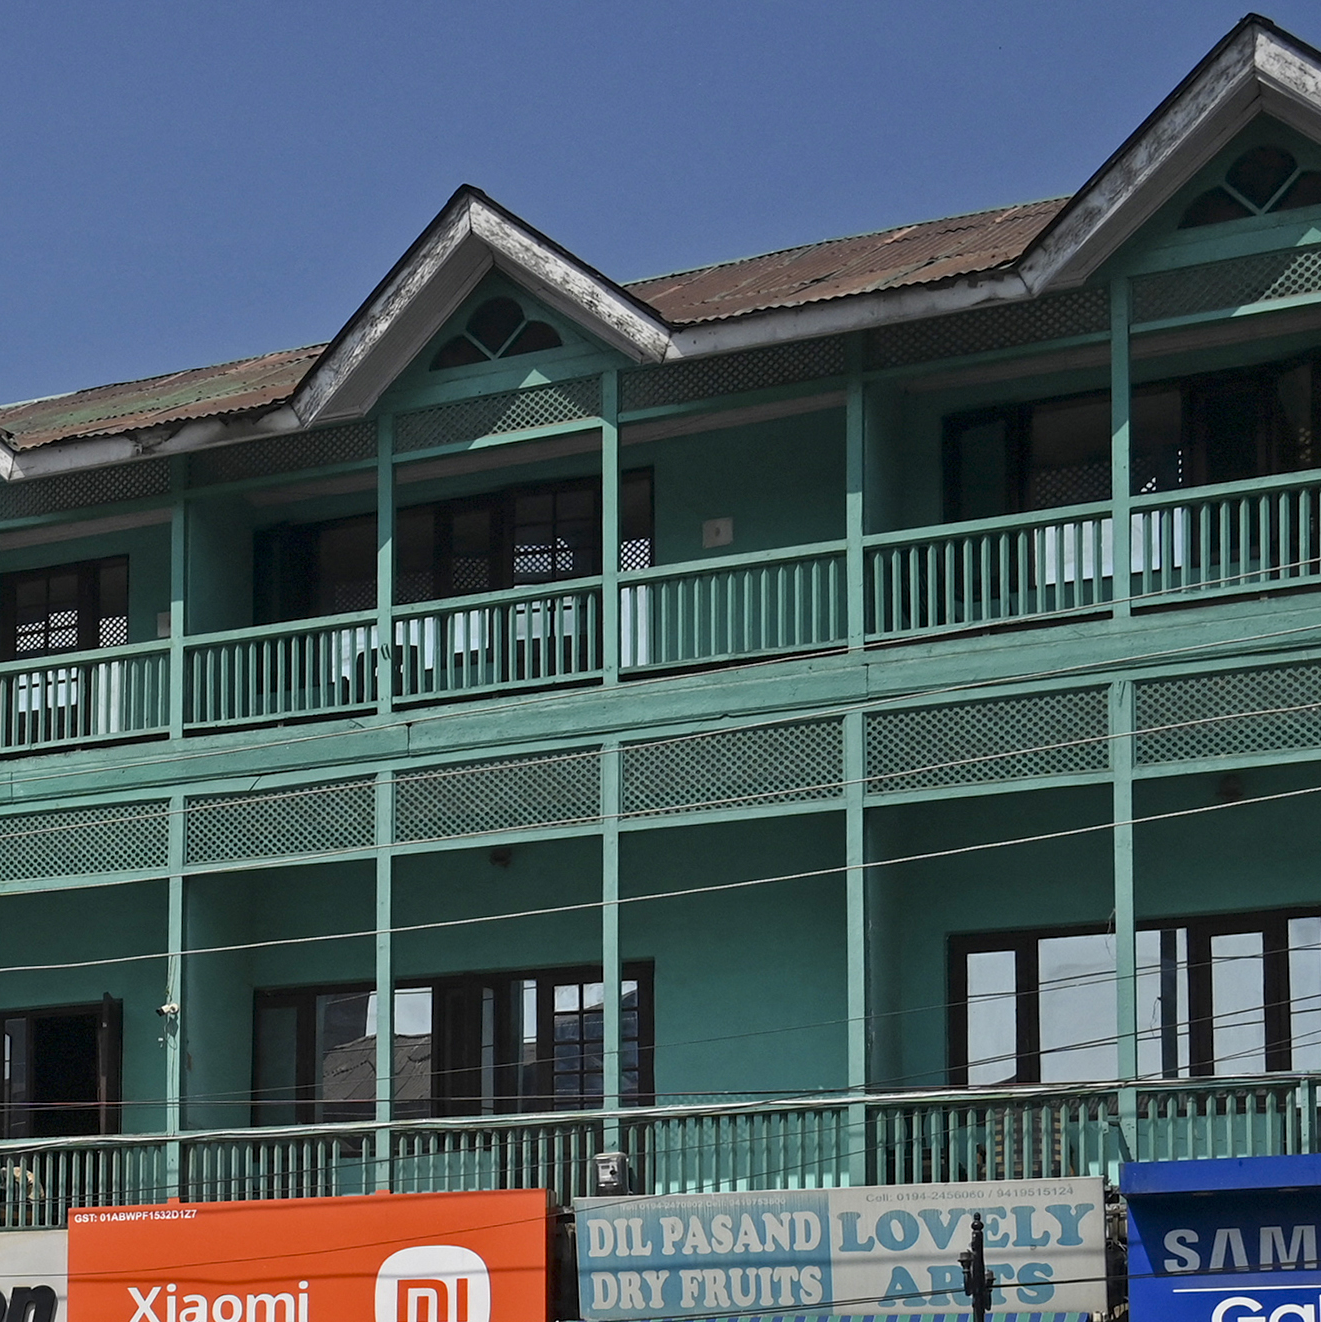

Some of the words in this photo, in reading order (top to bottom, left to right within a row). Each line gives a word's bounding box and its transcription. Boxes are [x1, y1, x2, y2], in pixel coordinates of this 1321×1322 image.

[74, 1213, 98, 1223] GST:
[99, 1209, 197, 1222] 01ABWPF1532D1Z7
[987, 1189, 993, 1199] /
[587, 1218, 653, 1258] DIL
[659, 1211, 822, 1256] PASAND
[836, 1203, 1095, 1253] LOVELY
[1163, 1224, 1319, 1275] SAM
[590, 1270, 670, 1310] DRY
[679, 1265, 823, 1309] FRUITS
[878, 1262, 1056, 1308] ARTS
